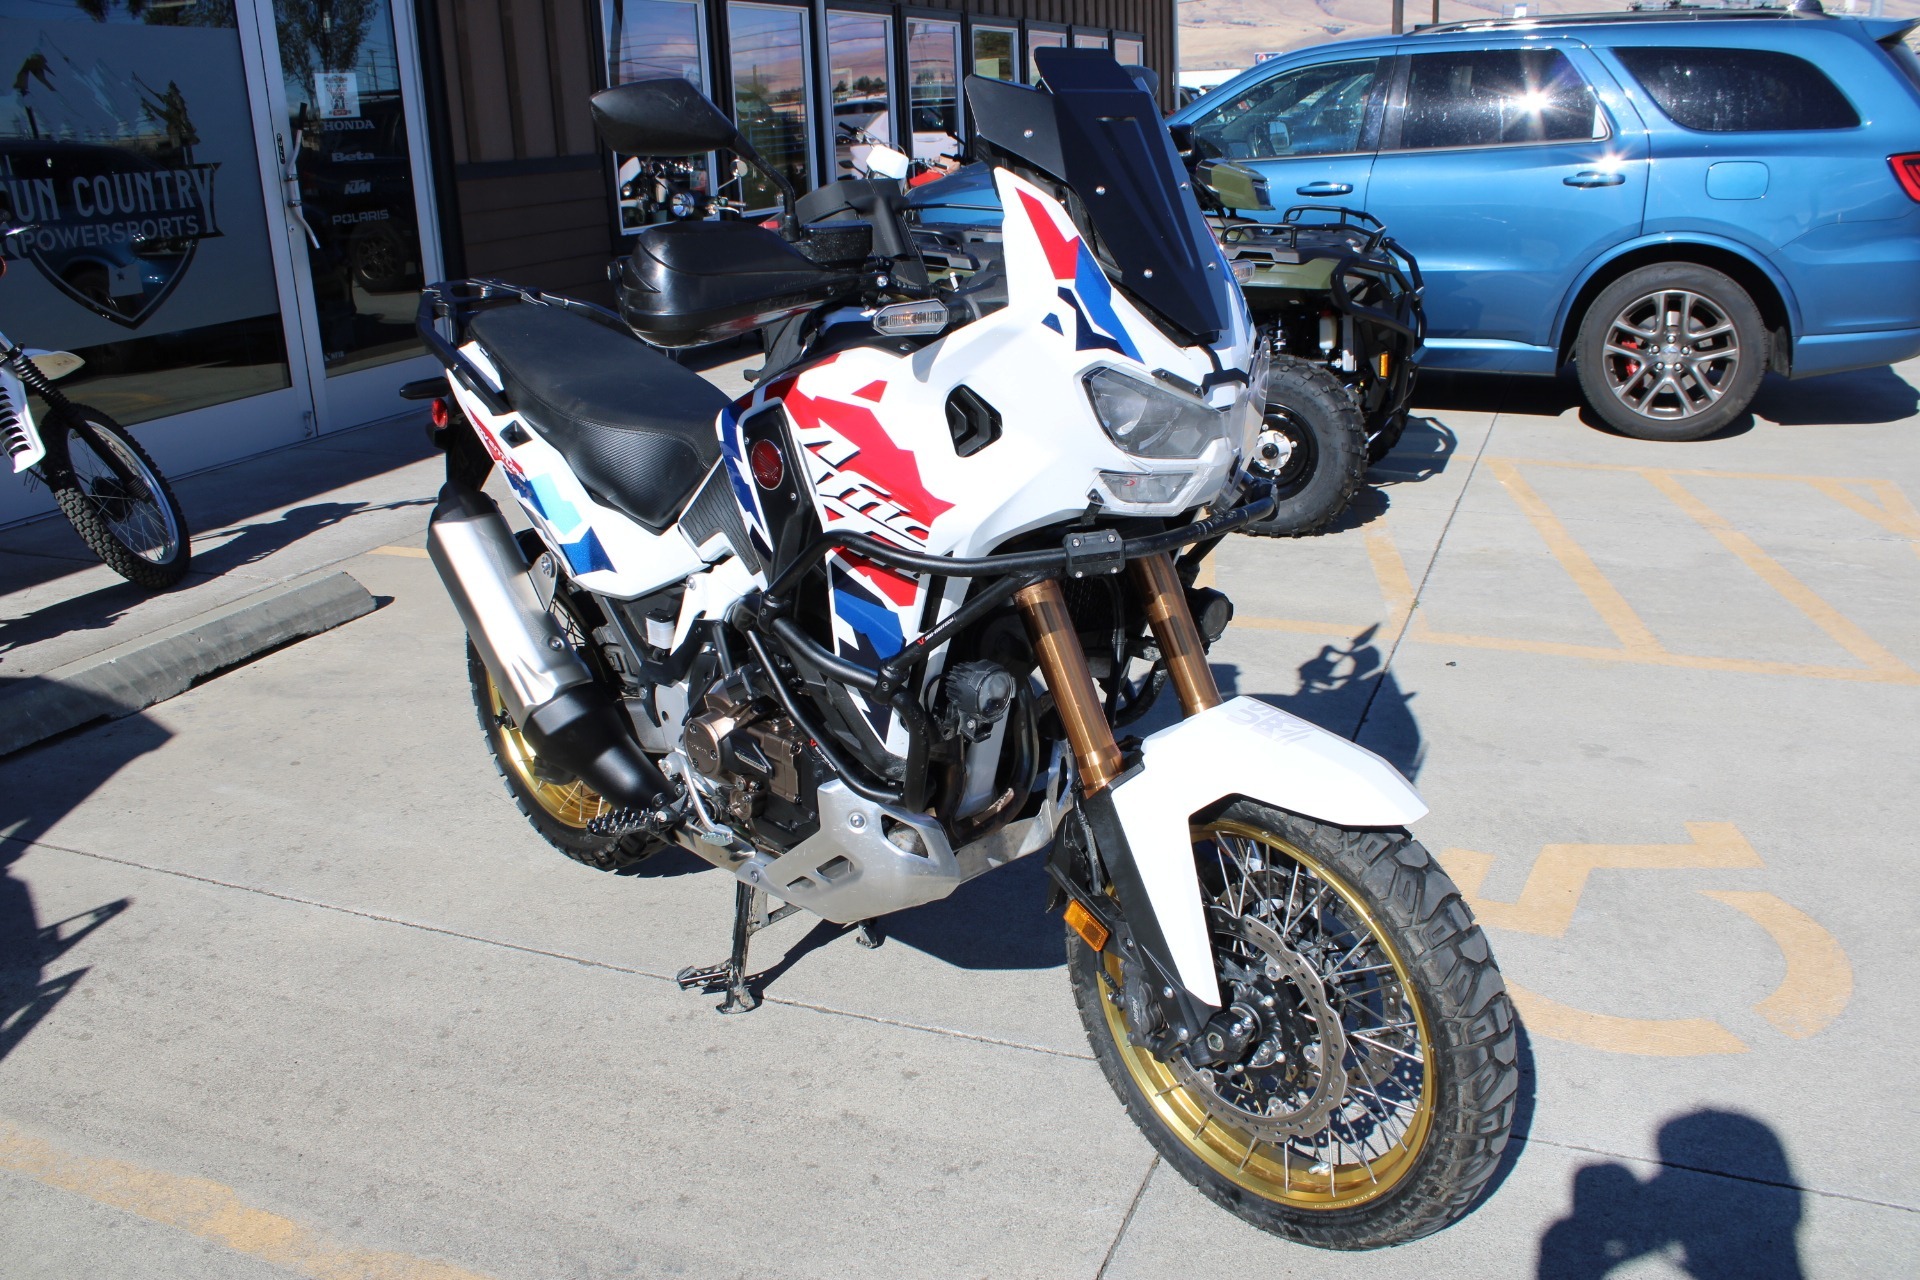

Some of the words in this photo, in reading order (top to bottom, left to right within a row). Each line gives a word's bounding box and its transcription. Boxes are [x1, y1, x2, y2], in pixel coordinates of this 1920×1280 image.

[322, 119, 376, 131] HONDA
[277, 134, 285, 161] PULL
[332, 152, 375, 162] Beta
[344, 179, 371, 195] KTM
[72, 167, 213, 234] COUNTRY
[332, 209, 390, 225] POLARIS
[20, 214, 200, 253] POWERSPORTS
